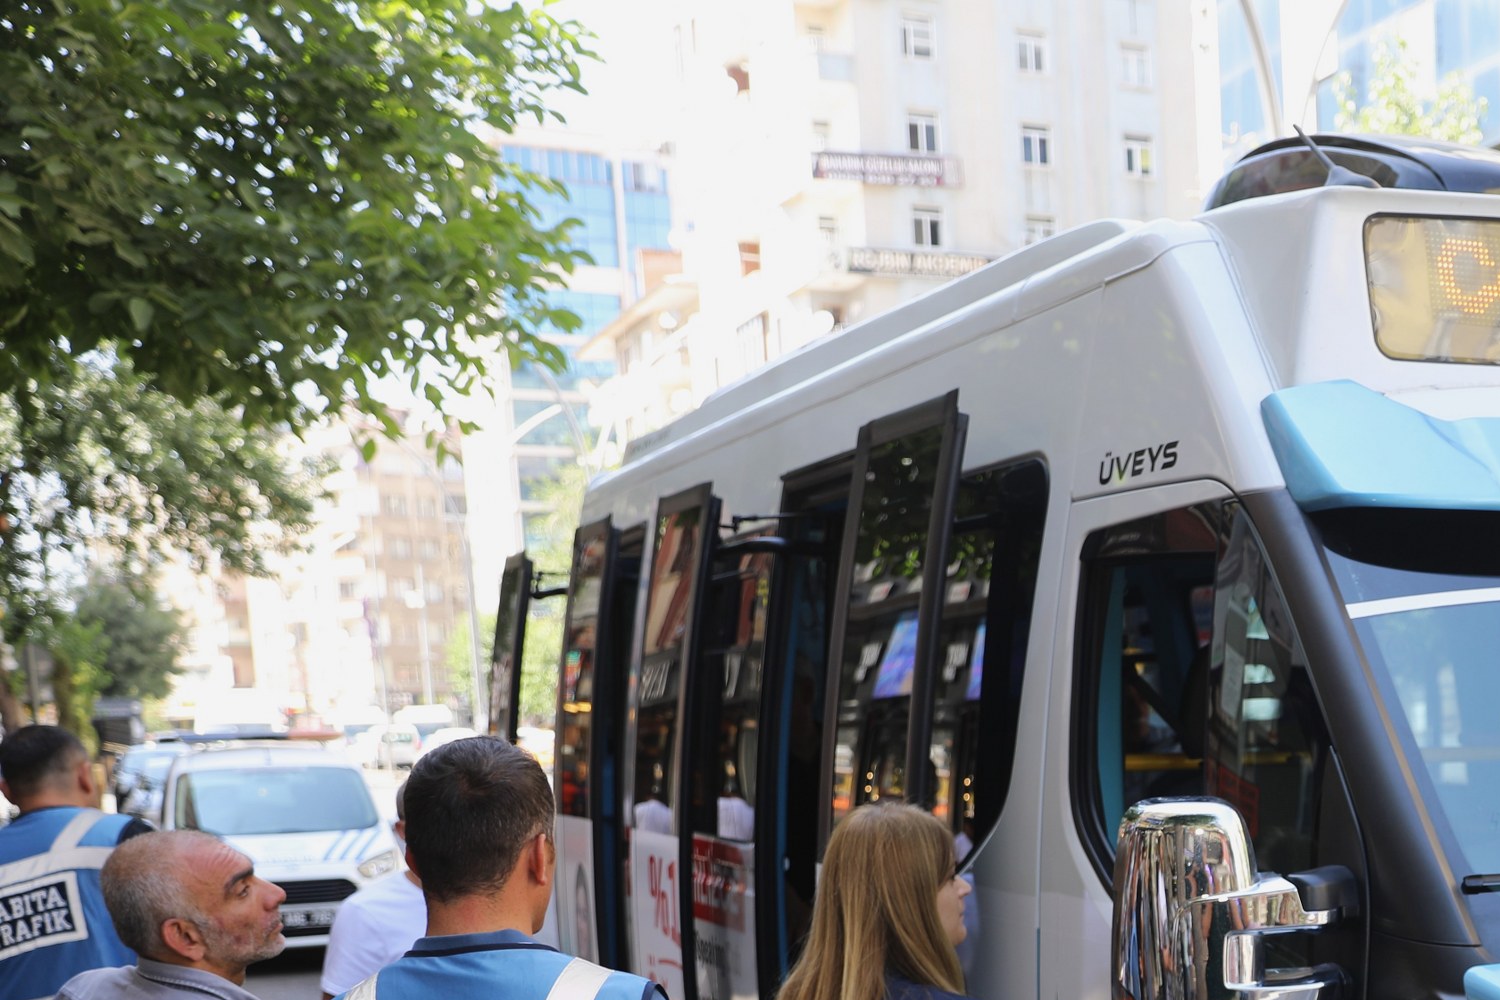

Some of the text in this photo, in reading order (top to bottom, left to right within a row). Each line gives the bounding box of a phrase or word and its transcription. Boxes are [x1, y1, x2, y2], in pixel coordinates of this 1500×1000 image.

[1099, 440, 1179, 485] ÜVEYS
[0, 886, 67, 923] ABITA
[0, 908, 72, 946] RAFİK
